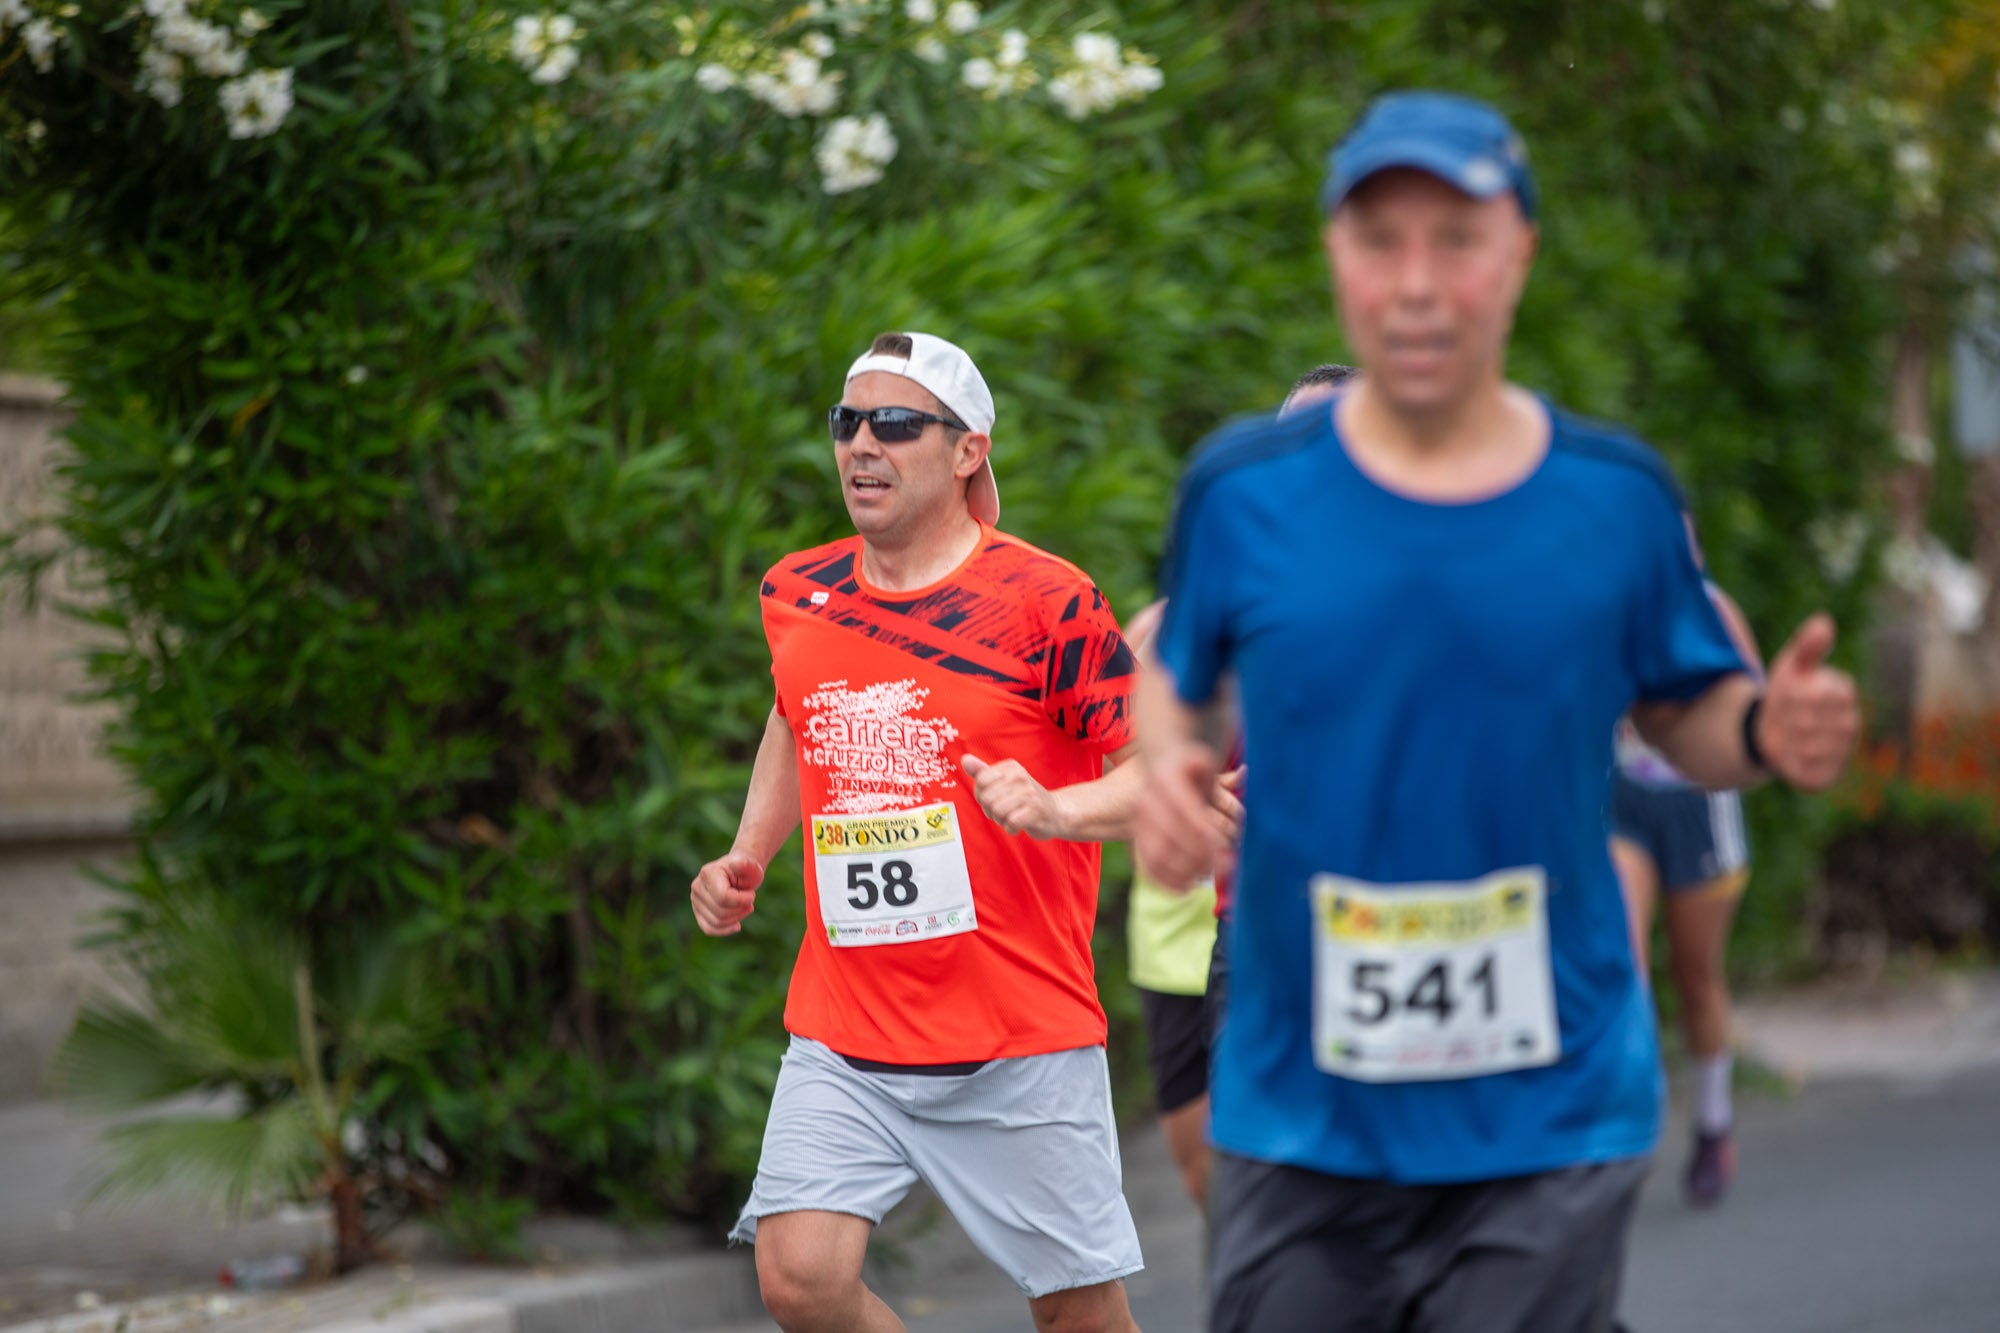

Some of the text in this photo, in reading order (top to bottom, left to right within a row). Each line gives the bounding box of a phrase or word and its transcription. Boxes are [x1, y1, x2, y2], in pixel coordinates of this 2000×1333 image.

[808, 714, 940, 752] carrera
[826, 823, 844, 846] 38
[844, 825, 919, 847] FONDO
[846, 821, 870, 830] GRAN
[872, 817, 909, 828] PREMIO
[847, 860, 918, 910] 58
[1347, 953, 1496, 1025] 541
